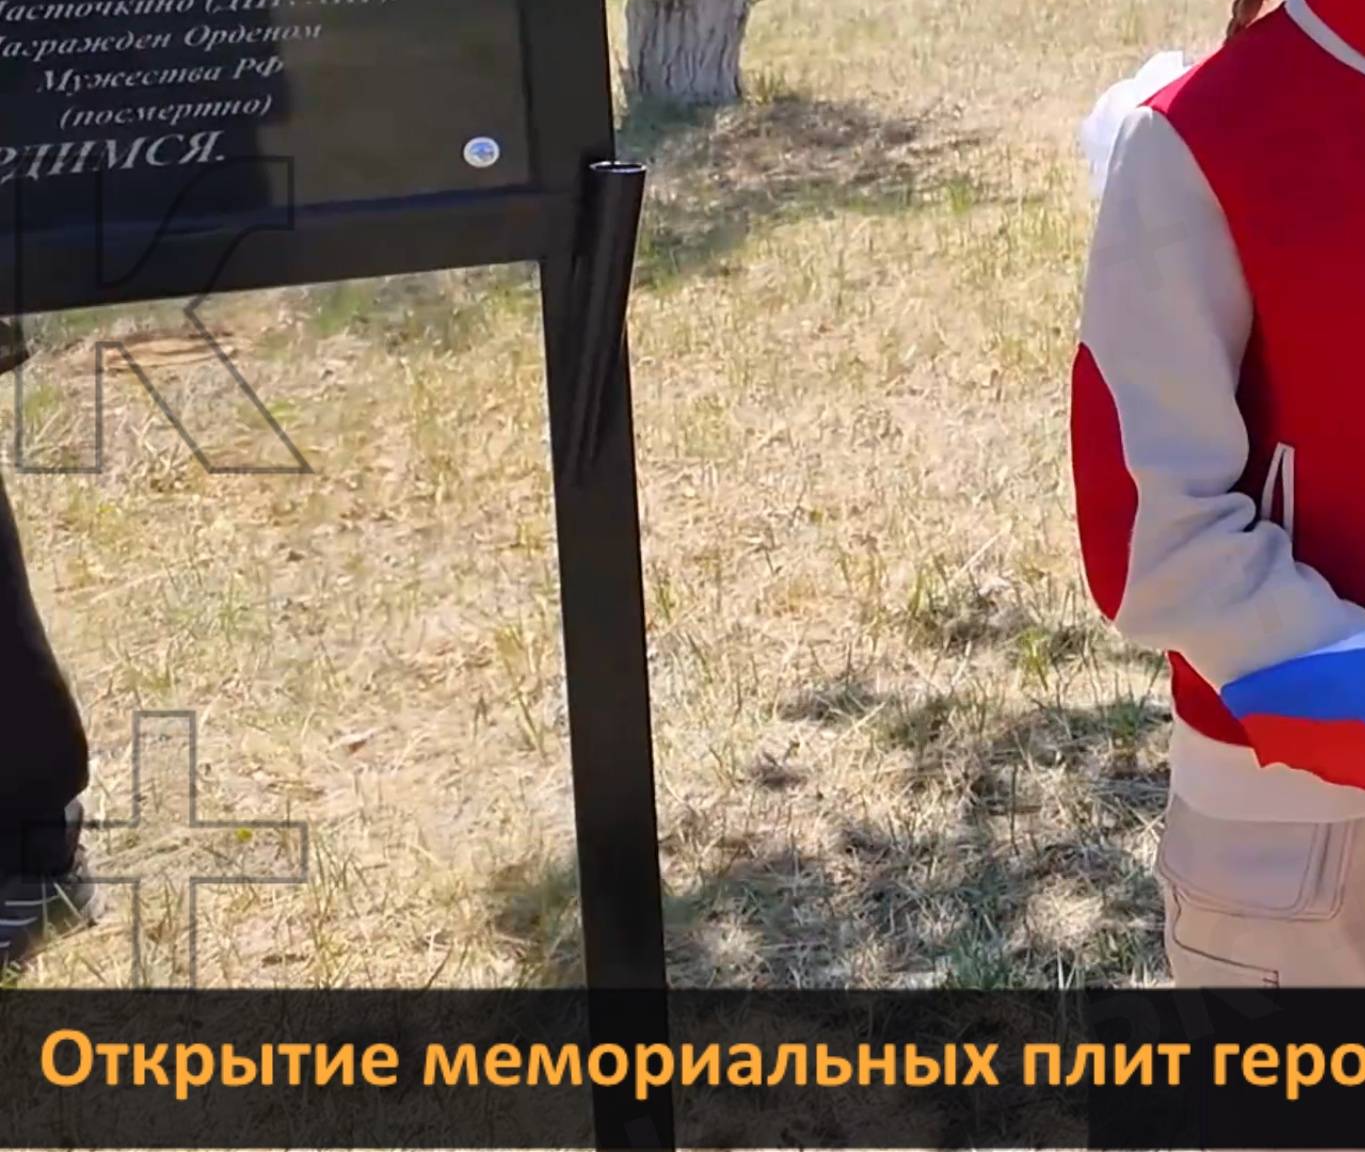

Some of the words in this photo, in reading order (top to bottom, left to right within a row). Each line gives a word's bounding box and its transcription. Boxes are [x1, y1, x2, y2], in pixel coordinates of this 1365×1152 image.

[184, 22, 323, 52] Орденом
[36, 67, 222, 96] Мужества
[233, 54, 286, 80] РФ
[59, 94, 273, 130] (посмертно)
